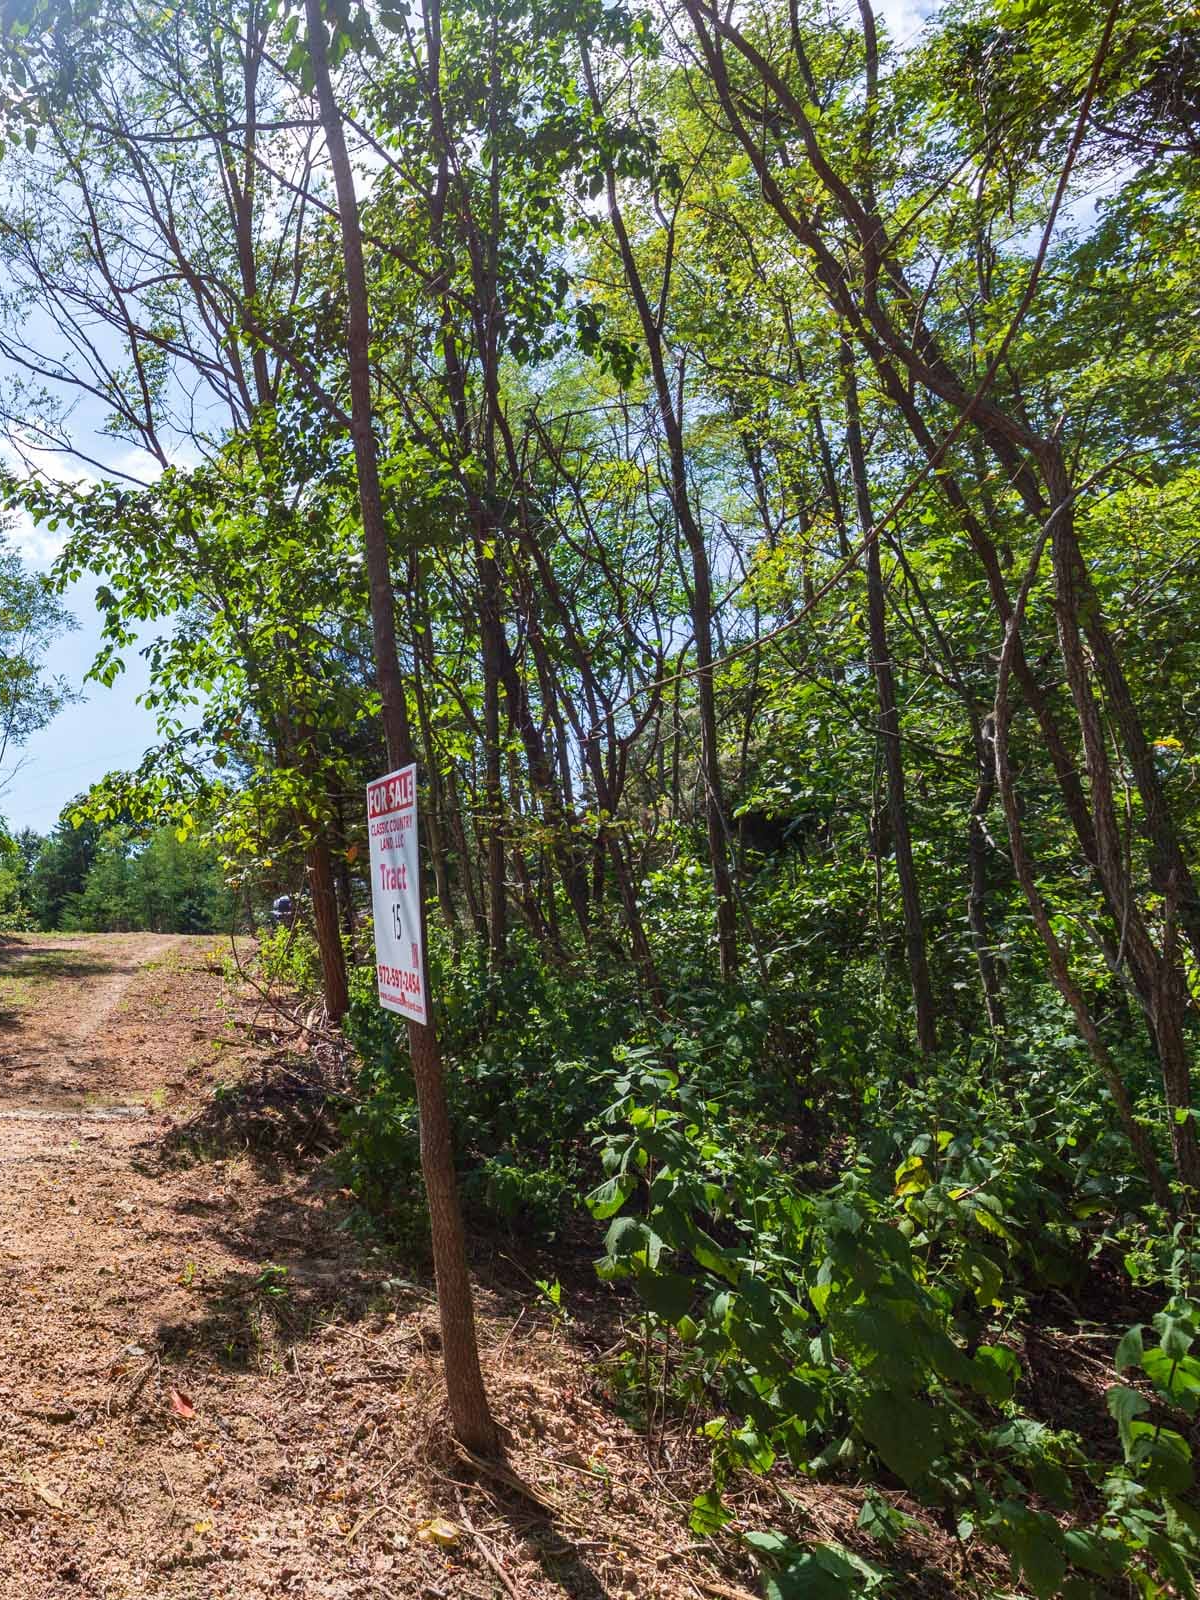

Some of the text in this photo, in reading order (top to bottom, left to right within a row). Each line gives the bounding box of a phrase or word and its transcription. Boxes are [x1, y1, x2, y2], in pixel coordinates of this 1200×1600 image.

[369, 776, 413, 814] FOR SALE
[371, 815, 412, 836] CLASSIC COUNTRY
[380, 864, 407, 890] Tract
[392, 904, 401, 939] 15
[379, 966, 420, 994] 972-597-2454
